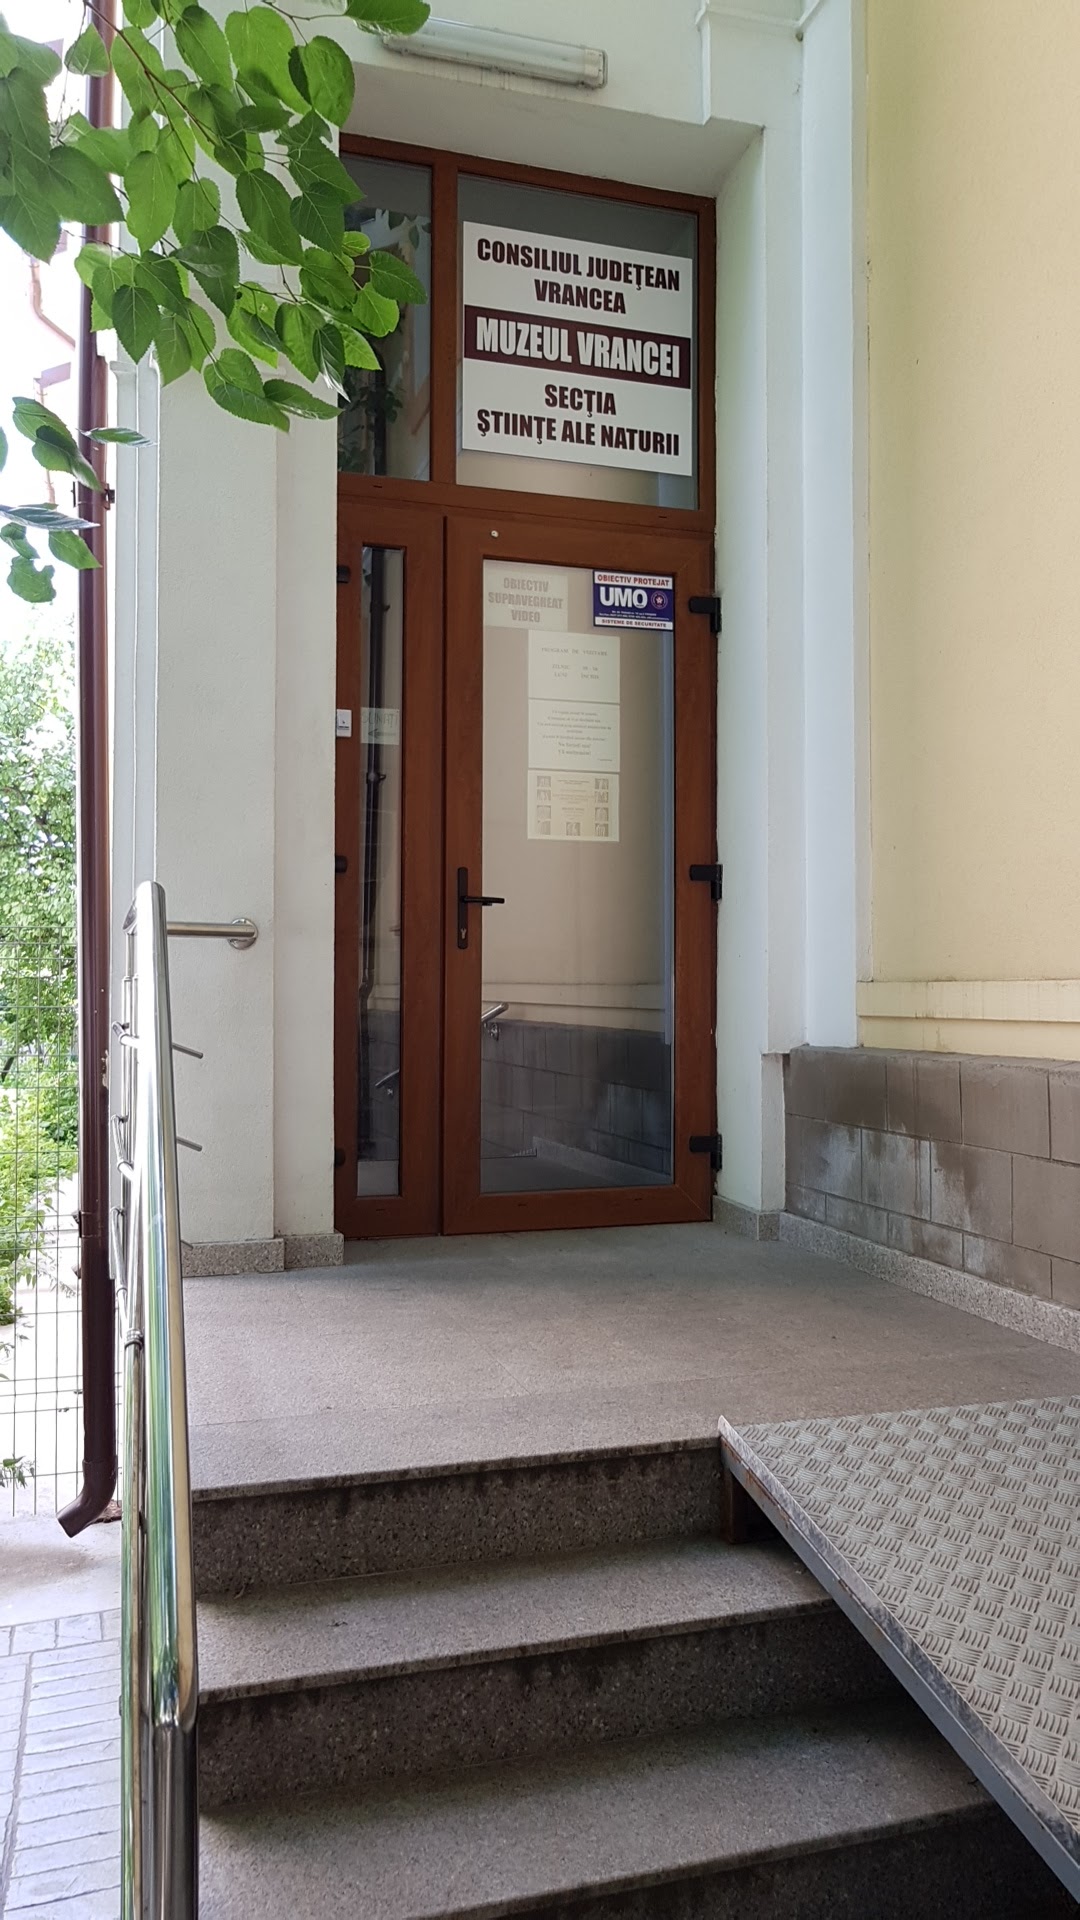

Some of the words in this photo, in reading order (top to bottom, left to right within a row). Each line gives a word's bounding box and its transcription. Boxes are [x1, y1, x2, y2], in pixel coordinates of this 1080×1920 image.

[478, 238, 582, 276] CONSILIUL
[534, 279, 626, 314] VRANCEA
[476, 316, 572, 363] MUZEUL
[577, 331, 680, 378] VRANCEI
[561, 420, 596, 446] ALE
[601, 425, 680, 456] NATURII
[504, 577, 549, 592] OBIECTIV
[598, 574, 632, 584] OBIECTIV
[634, 577, 670, 586] PROTEJAT
[488, 592, 563, 608] SUPRAVEGHEAT
[600, 586, 648, 608] UMO
[511, 610, 540, 622] VIDEO
